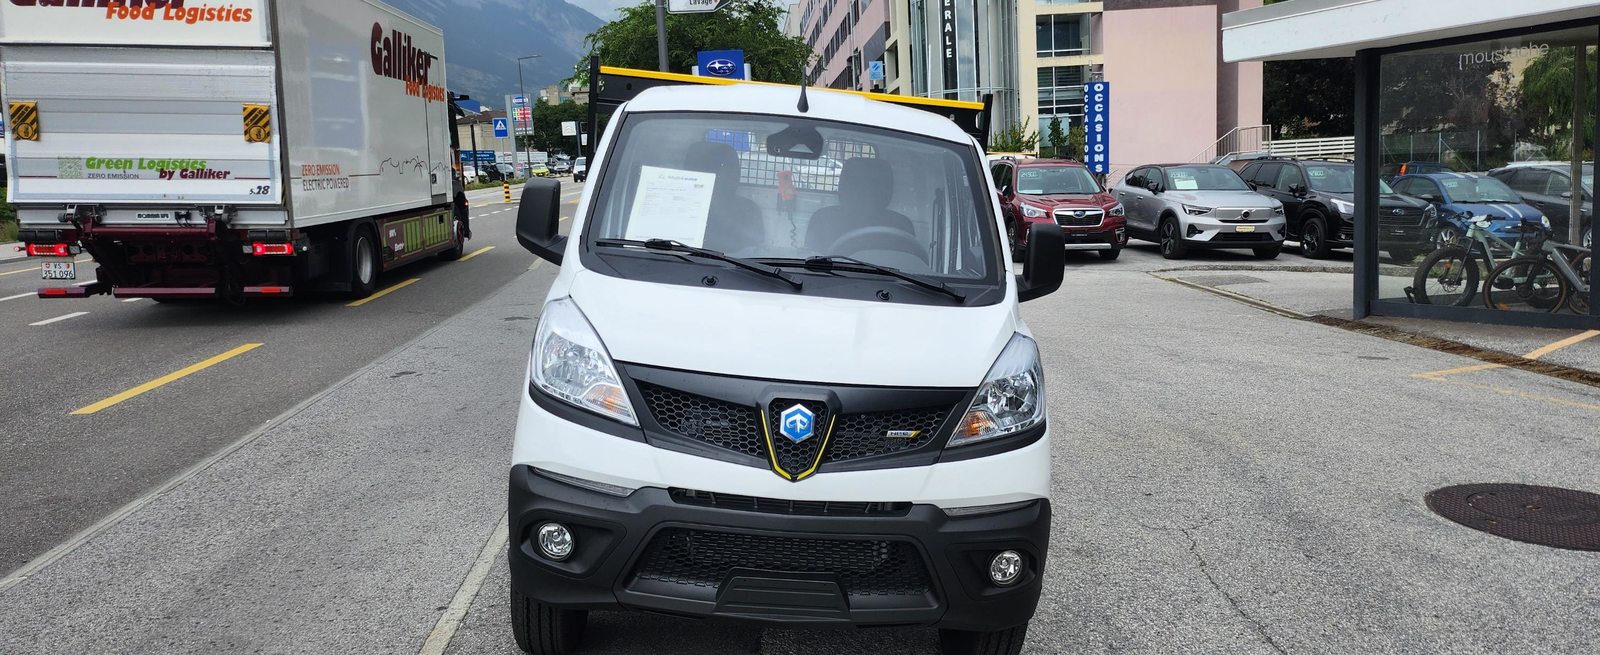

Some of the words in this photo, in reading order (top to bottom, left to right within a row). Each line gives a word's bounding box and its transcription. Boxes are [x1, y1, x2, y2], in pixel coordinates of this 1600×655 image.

[105, 1, 155, 20] Food
[163, 2, 253, 25] Logistics
[370, 22, 432, 86] Galliker
[405, 75, 420, 97] Food
[422, 80, 445, 103] Logistics
[1094, 83, 1104, 172] OCCASIONS
[85, 156, 134, 170] Green
[138, 157, 208, 172] Logistics
[302, 164, 316, 177] ZERO
[317, 163, 340, 176] EMISSION
[159, 168, 175, 180] by
[179, 168, 231, 180] Galliker
[303, 179, 325, 191] ELECTRIC
[326, 177, 349, 190] POWERED
[44, 270, 57, 278] 351
[59, 270, 73, 278] 096
